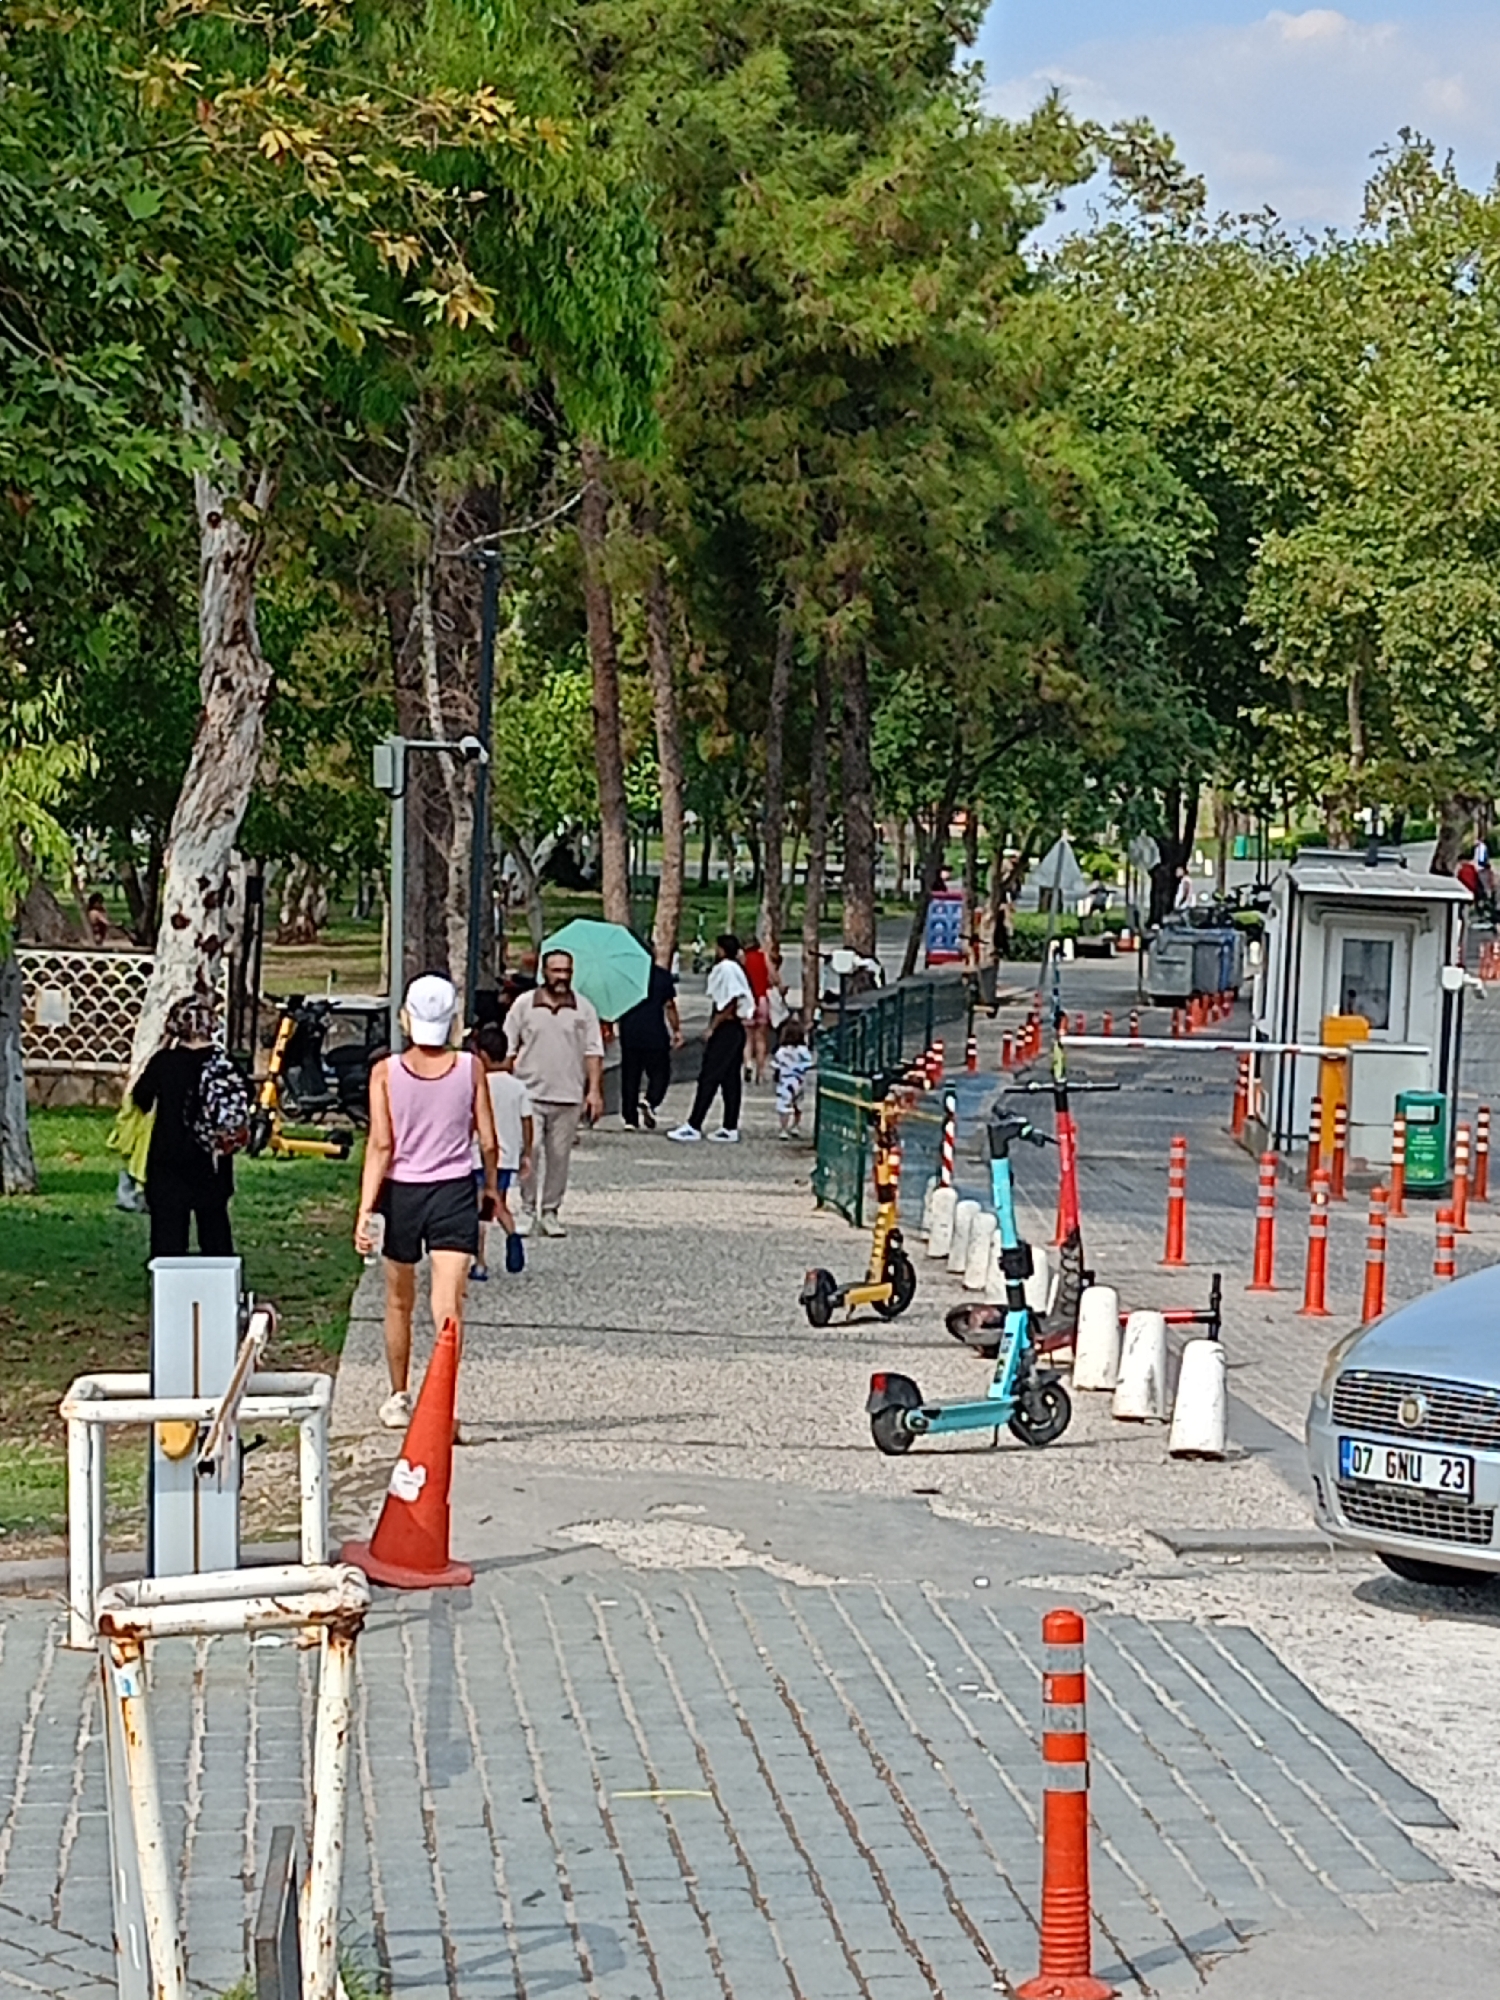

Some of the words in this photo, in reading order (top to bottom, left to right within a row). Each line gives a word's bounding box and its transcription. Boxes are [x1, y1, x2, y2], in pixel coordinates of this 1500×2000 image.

[1352, 1445, 1373, 1475] 07
[1386, 1450, 1422, 1483] GNU
[1440, 1458, 1465, 1489] 23
